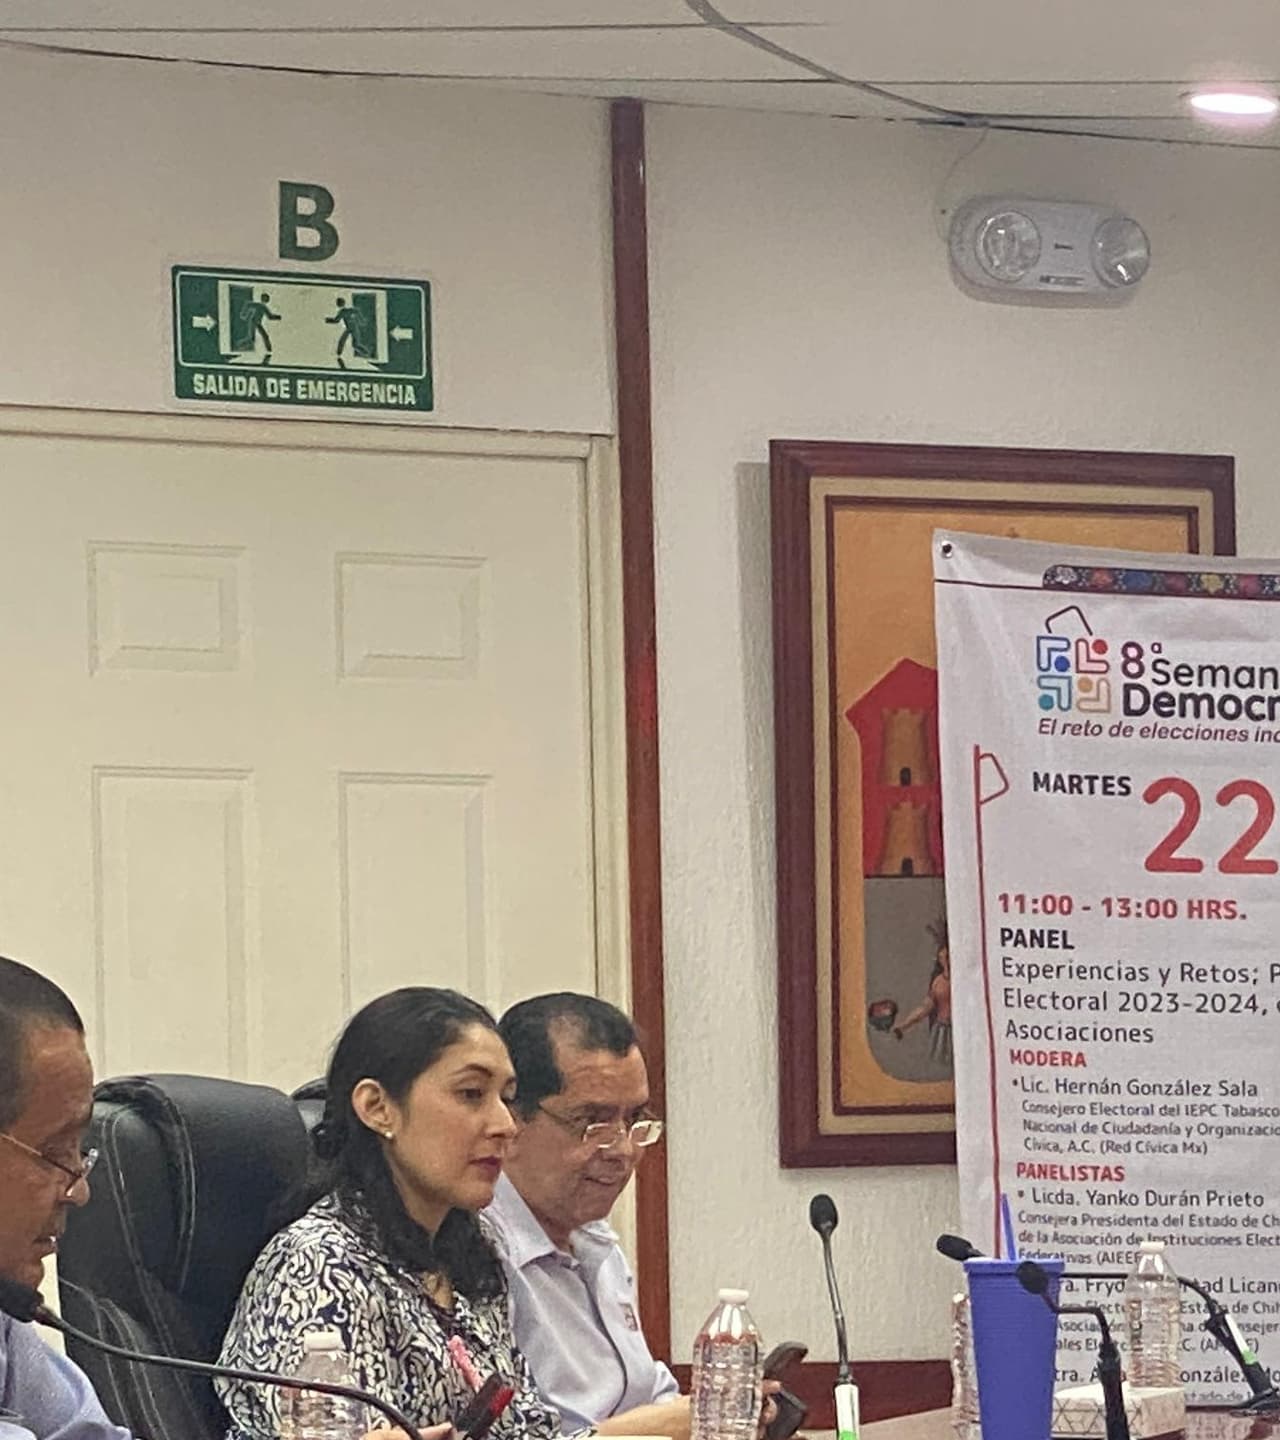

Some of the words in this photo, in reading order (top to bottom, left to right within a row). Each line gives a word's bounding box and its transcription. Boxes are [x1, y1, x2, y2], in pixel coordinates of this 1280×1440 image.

[279, 180, 340, 262] B
[193, 373, 260, 398] SALIDA
[266, 377, 290, 399] DE
[296, 379, 417, 406] EMERGENCIA
[1038, 718, 1056, 736] El
[1061, 719, 1103, 738] reto
[1108, 722, 1133, 740] de
[1140, 723, 1249, 743] elecciones
[1032, 771, 1133, 797] MARTES
[1142, 777, 1280, 875] 22
[998, 893, 1073, 917] 11:00
[1101, 896, 1178, 920] 13:00
[1186, 898, 1247, 921] HRS.
[1000, 927, 1075, 950] PANEL
[1001, 957, 1150, 984] Experiencias
[1159, 967, 1170, 988] y
[1180, 963, 1259, 986] Retos;
[1003, 988, 1109, 1011] Electoral
[1117, 992, 1268, 1017] 2023-2024,
[1005, 1019, 1154, 1043] Asociaciones
[1009, 1049, 1088, 1068] MODERA
[1055, 1077, 1122, 1096] Hernán
[1127, 1078, 1212, 1098] González
[1218, 1080, 1259, 1098] Sala
[1022, 1099, 1086, 1118] Consejero
[1089, 1101, 1154, 1117] Electoral
[1159, 1102, 1180, 1117] del
[1185, 1103, 1216, 1118] IEPC
[1224, 1104, 1280, 1118] Tabasco
[1023, 1118, 1077, 1135] Nacional
[1080, 1119, 1099, 1135] de
[1102, 1120, 1182, 1136] Ciudadanía
[1185, 1124, 1193, 1139] y
[1016, 1162, 1126, 1182] PANELISTAS
[1032, 1187, 1080, 1207] Licda.
[1086, 1189, 1139, 1207] Yanko
[1145, 1189, 1200, 1207] Durán
[1206, 1190, 1265, 1208] Prieto
[1018, 1211, 1078, 1228] Consejera
[1081, 1213, 1158, 1228] Presidenta
[1162, 1214, 1184, 1228] del
[1188, 1214, 1238, 1228] Estado
[1242, 1214, 1259, 1228] de
